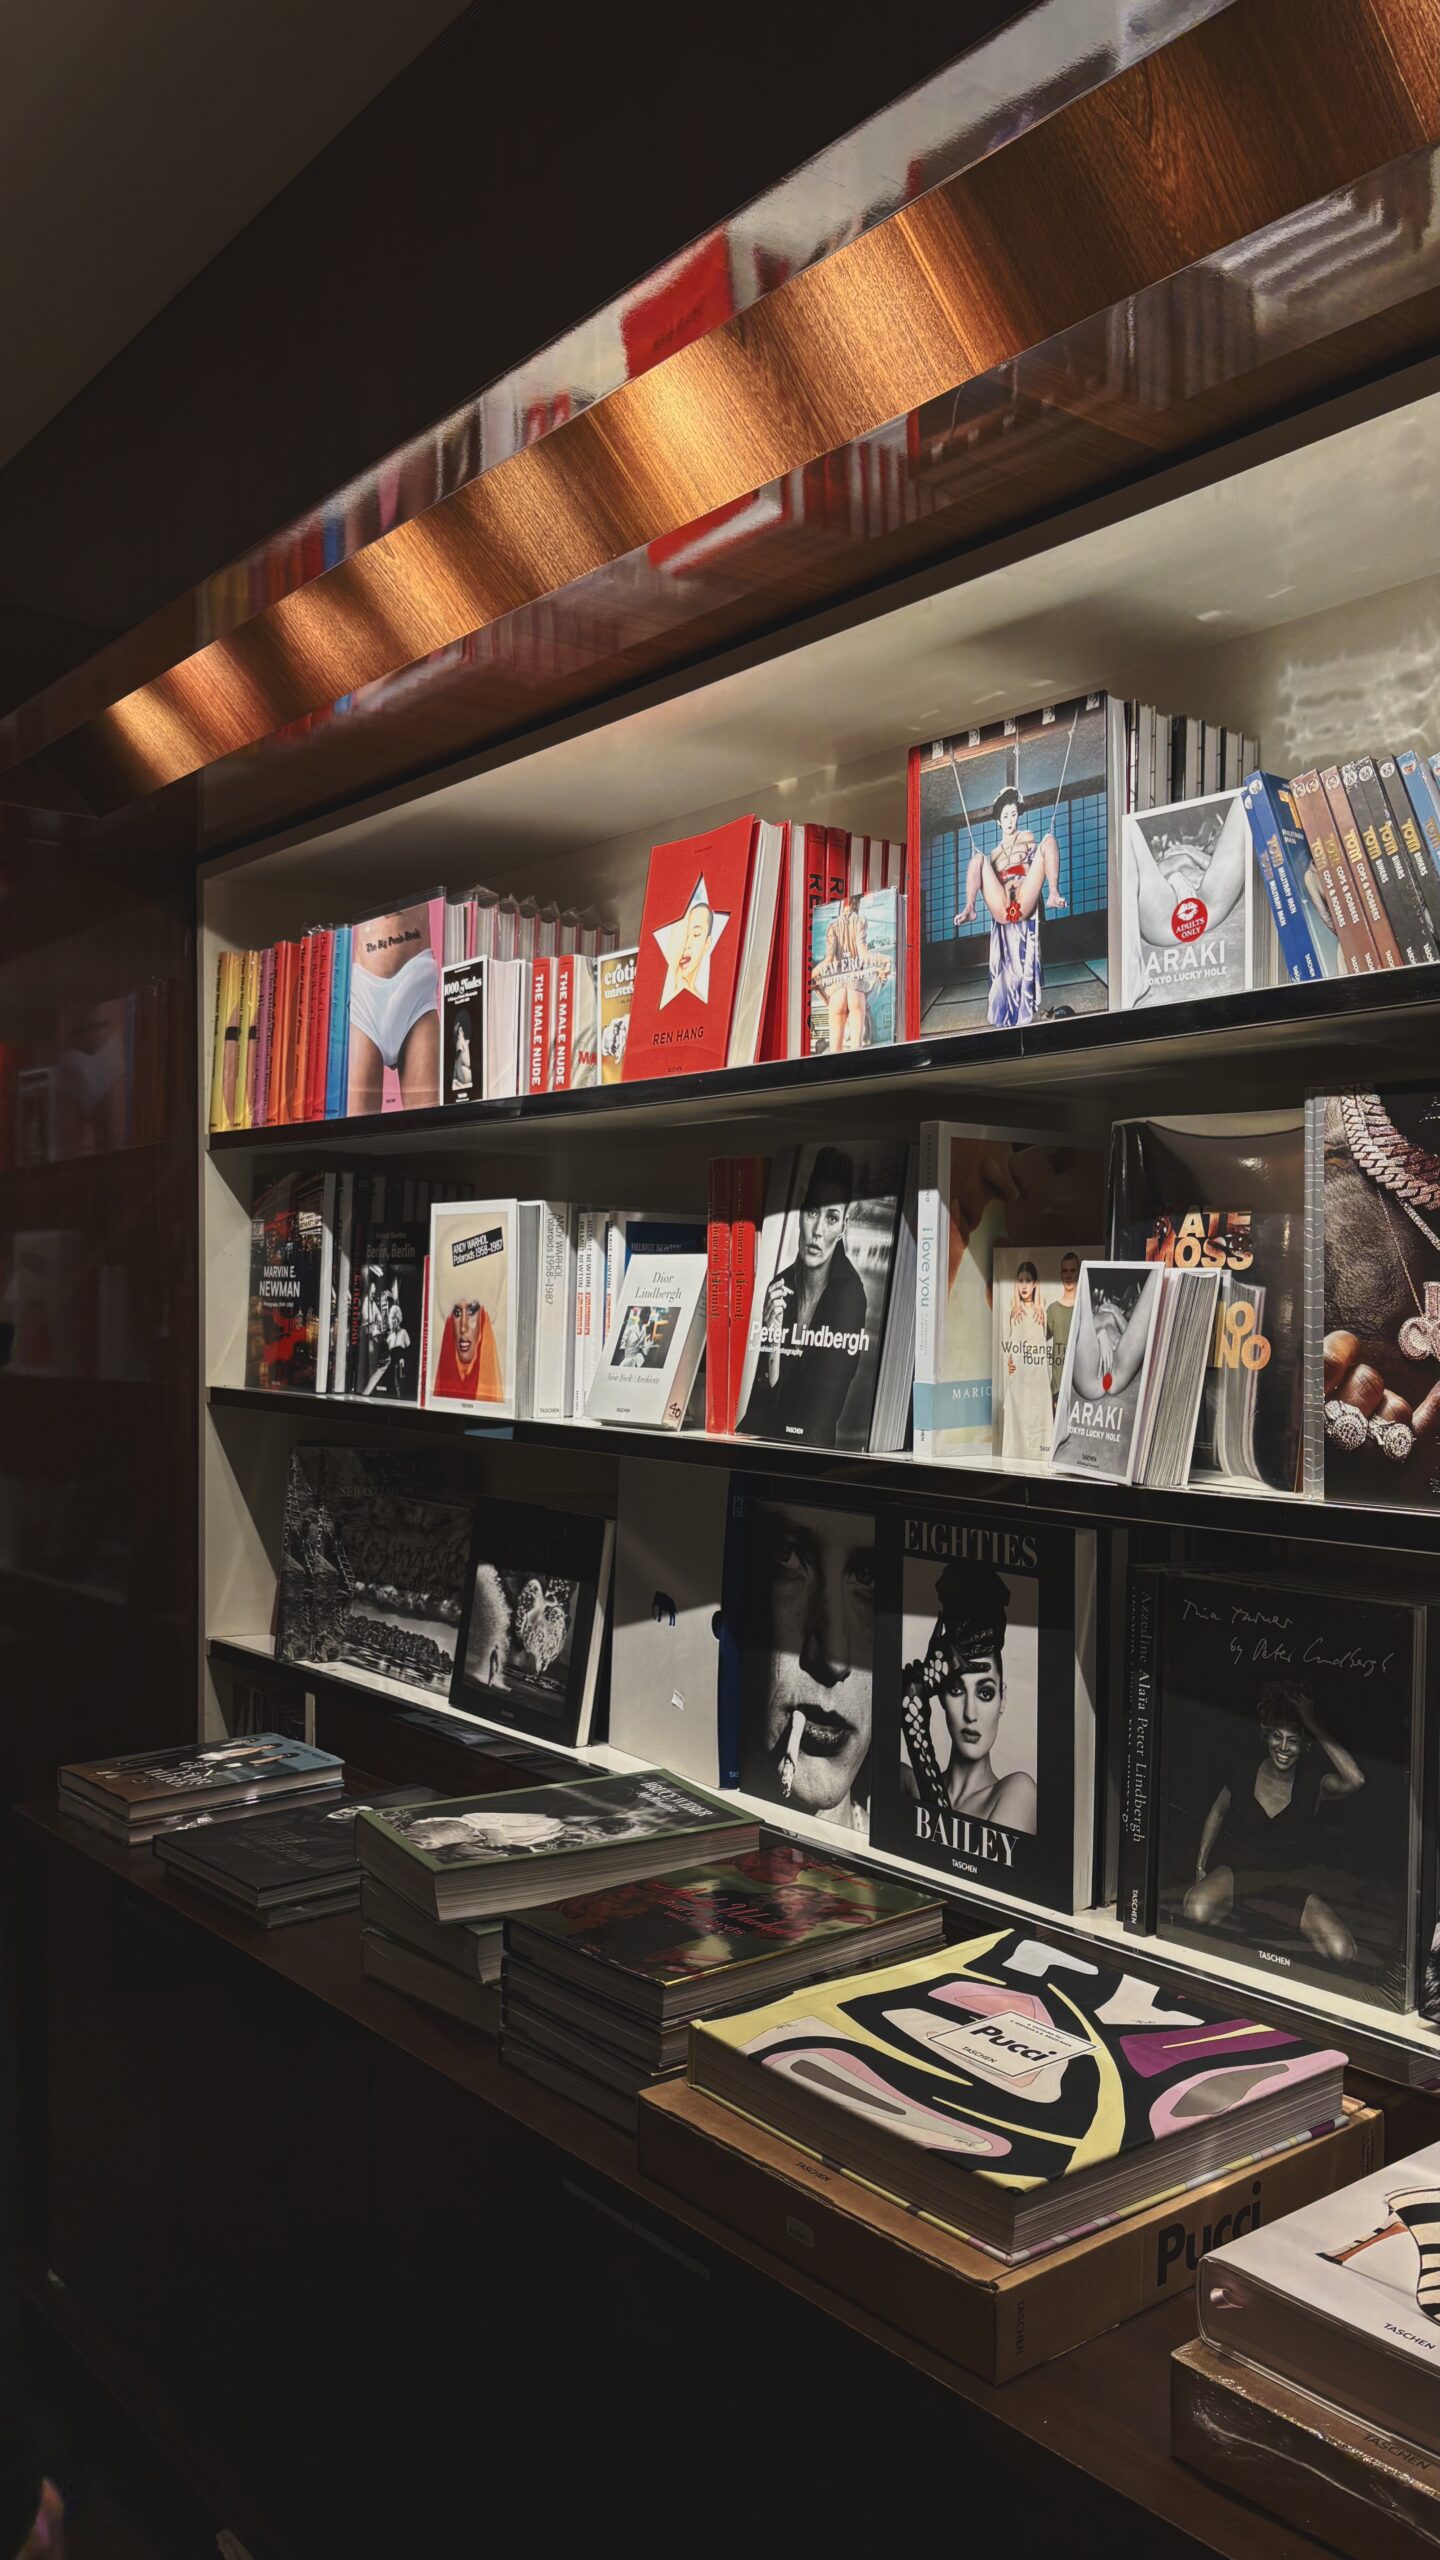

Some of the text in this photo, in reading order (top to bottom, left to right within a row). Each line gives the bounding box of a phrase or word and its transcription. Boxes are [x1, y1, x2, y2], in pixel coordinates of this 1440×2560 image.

[1362, 826, 1388, 883] TOM BIKERS
[1379, 823, 1405, 879] TOM BIKERS
[1401, 819, 1427, 876] TOM BIKERS
[1335, 866, 1346, 884] COPS
[1342, 884, 1348, 892] &
[1343, 830, 1362, 862] TOM
[1356, 863, 1366, 881] COPS
[1365, 890, 1380, 920] ROBBERS
[1270, 881, 1283, 909] MILITARY
[1277, 910, 1286, 926] MEN
[1278, 867, 1291, 896] MILITARY
[1287, 898, 1297, 914] MEN
[1323, 870, 1333, 888] COPS
[1332, 897, 1346, 926] ROBBERS
[1344, 893, 1359, 923] ROBBERS
[1176, 917, 1205, 933] ADULTS
[1181, 927, 1201, 938] ONLY
[1146, 940, 1225, 974] ARAKI
[1304, 954, 1316, 977] TASCHEN
[604, 959, 636, 986] eroti
[1144, 966, 1228, 987] TOKYO LUCKY HOLE
[444, 981, 460, 996] 1000
[532, 974, 544, 1085] THE MALE NUDE
[556, 972, 568, 1085] THE MALE NUDE
[653, 1026, 704, 1045] REN HANG
[453, 1234, 488, 1254] ANDY WARHOL
[548, 1214, 556, 1254] Polaroids
[554, 1214, 565, 1278] ANDY WARHOL
[367, 1243, 416, 1262] Berlin, Berlin
[454, 1251, 475, 1265] Polaroids
[921, 1236, 934, 1268] love
[1146, 1237, 1254, 1271] MOSS
[263, 1264, 297, 1278] MARVIN E.
[652, 1272, 674, 1284] Dior
[259, 1280, 300, 1298] NEWMAN
[634, 1286, 682, 1302] Lindbergh
[920, 1271, 934, 1307] you
[750, 1320, 870, 1356] Peter Lindbergh
[774, 1346, 803, 1358] Photography
[1002, 1340, 1053, 1358] Wolfgang
[1024, 1354, 1046, 1366] four
[1068, 1400, 1124, 1431] ARAKI
[1067, 1426, 1120, 1442] TOKYO LUCKY HOLE
[904, 1520, 1038, 1568] EIGHTIES
[1182, 1598, 1221, 1620] Tina
[1230, 1636, 1243, 1664] by
[1303, 1636, 1394, 1678] Lindbergh
[1130, 1590, 1152, 1842] Azzedine Alaïa Peter Lindbergh
[640, 1782, 713, 1816] BRUCE WEBER
[914, 1806, 1020, 1868] BAILEY
[952, 1858, 978, 1874] TASCHEN
[1130, 1889, 1139, 1924] TASCHEN
[1258, 1950, 1290, 1966] TASCHEN
[962, 2046, 998, 2064] TASCHEN
[970, 2026, 1058, 2062] Pucci
[796, 2162, 832, 2182] TASCHEN
[1157, 2180, 1261, 2287] Pucci
[1016, 2300, 1025, 2355] TASCHEN
[1384, 2322, 1436, 2350] TASCHEN
